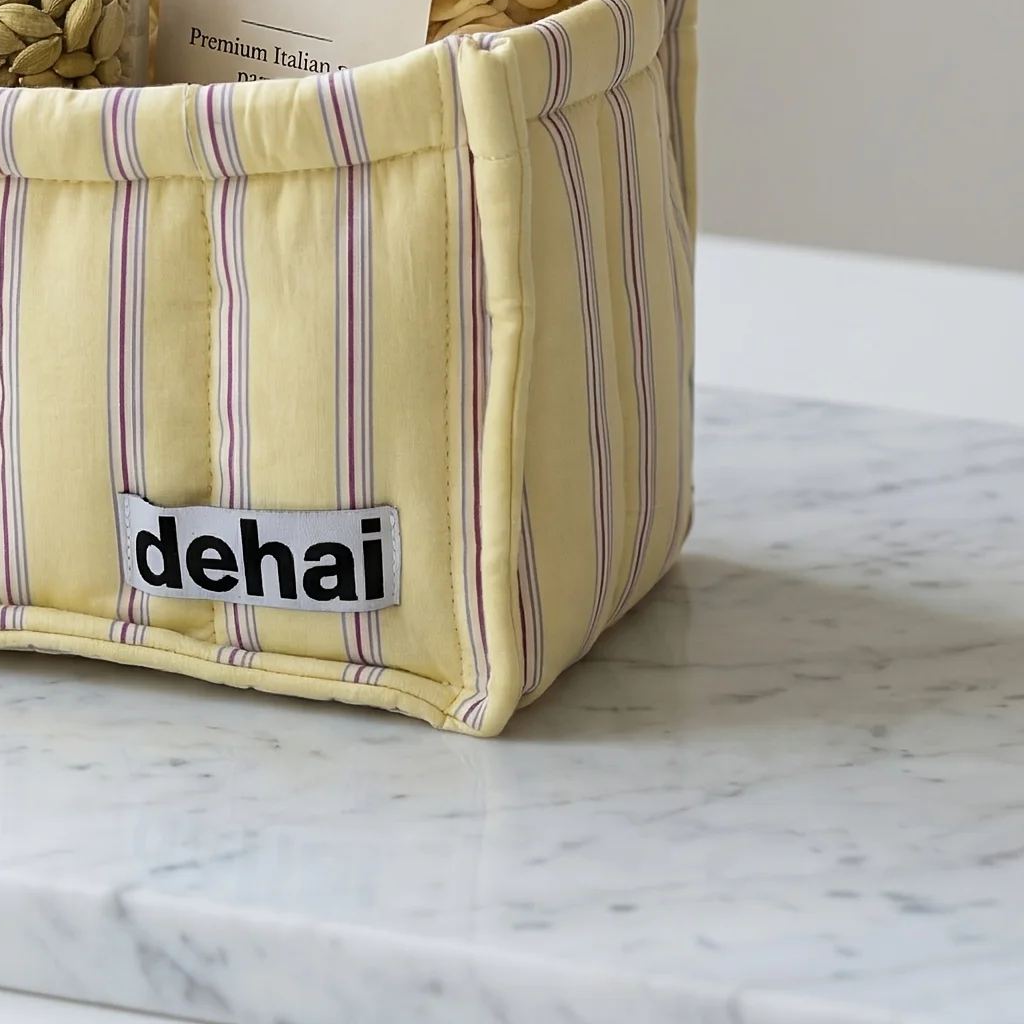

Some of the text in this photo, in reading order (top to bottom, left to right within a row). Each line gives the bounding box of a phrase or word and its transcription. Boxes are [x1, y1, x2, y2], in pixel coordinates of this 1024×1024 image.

[189, 27, 330, 73] Premium Italian
[136, 516, 384, 601] dehai
